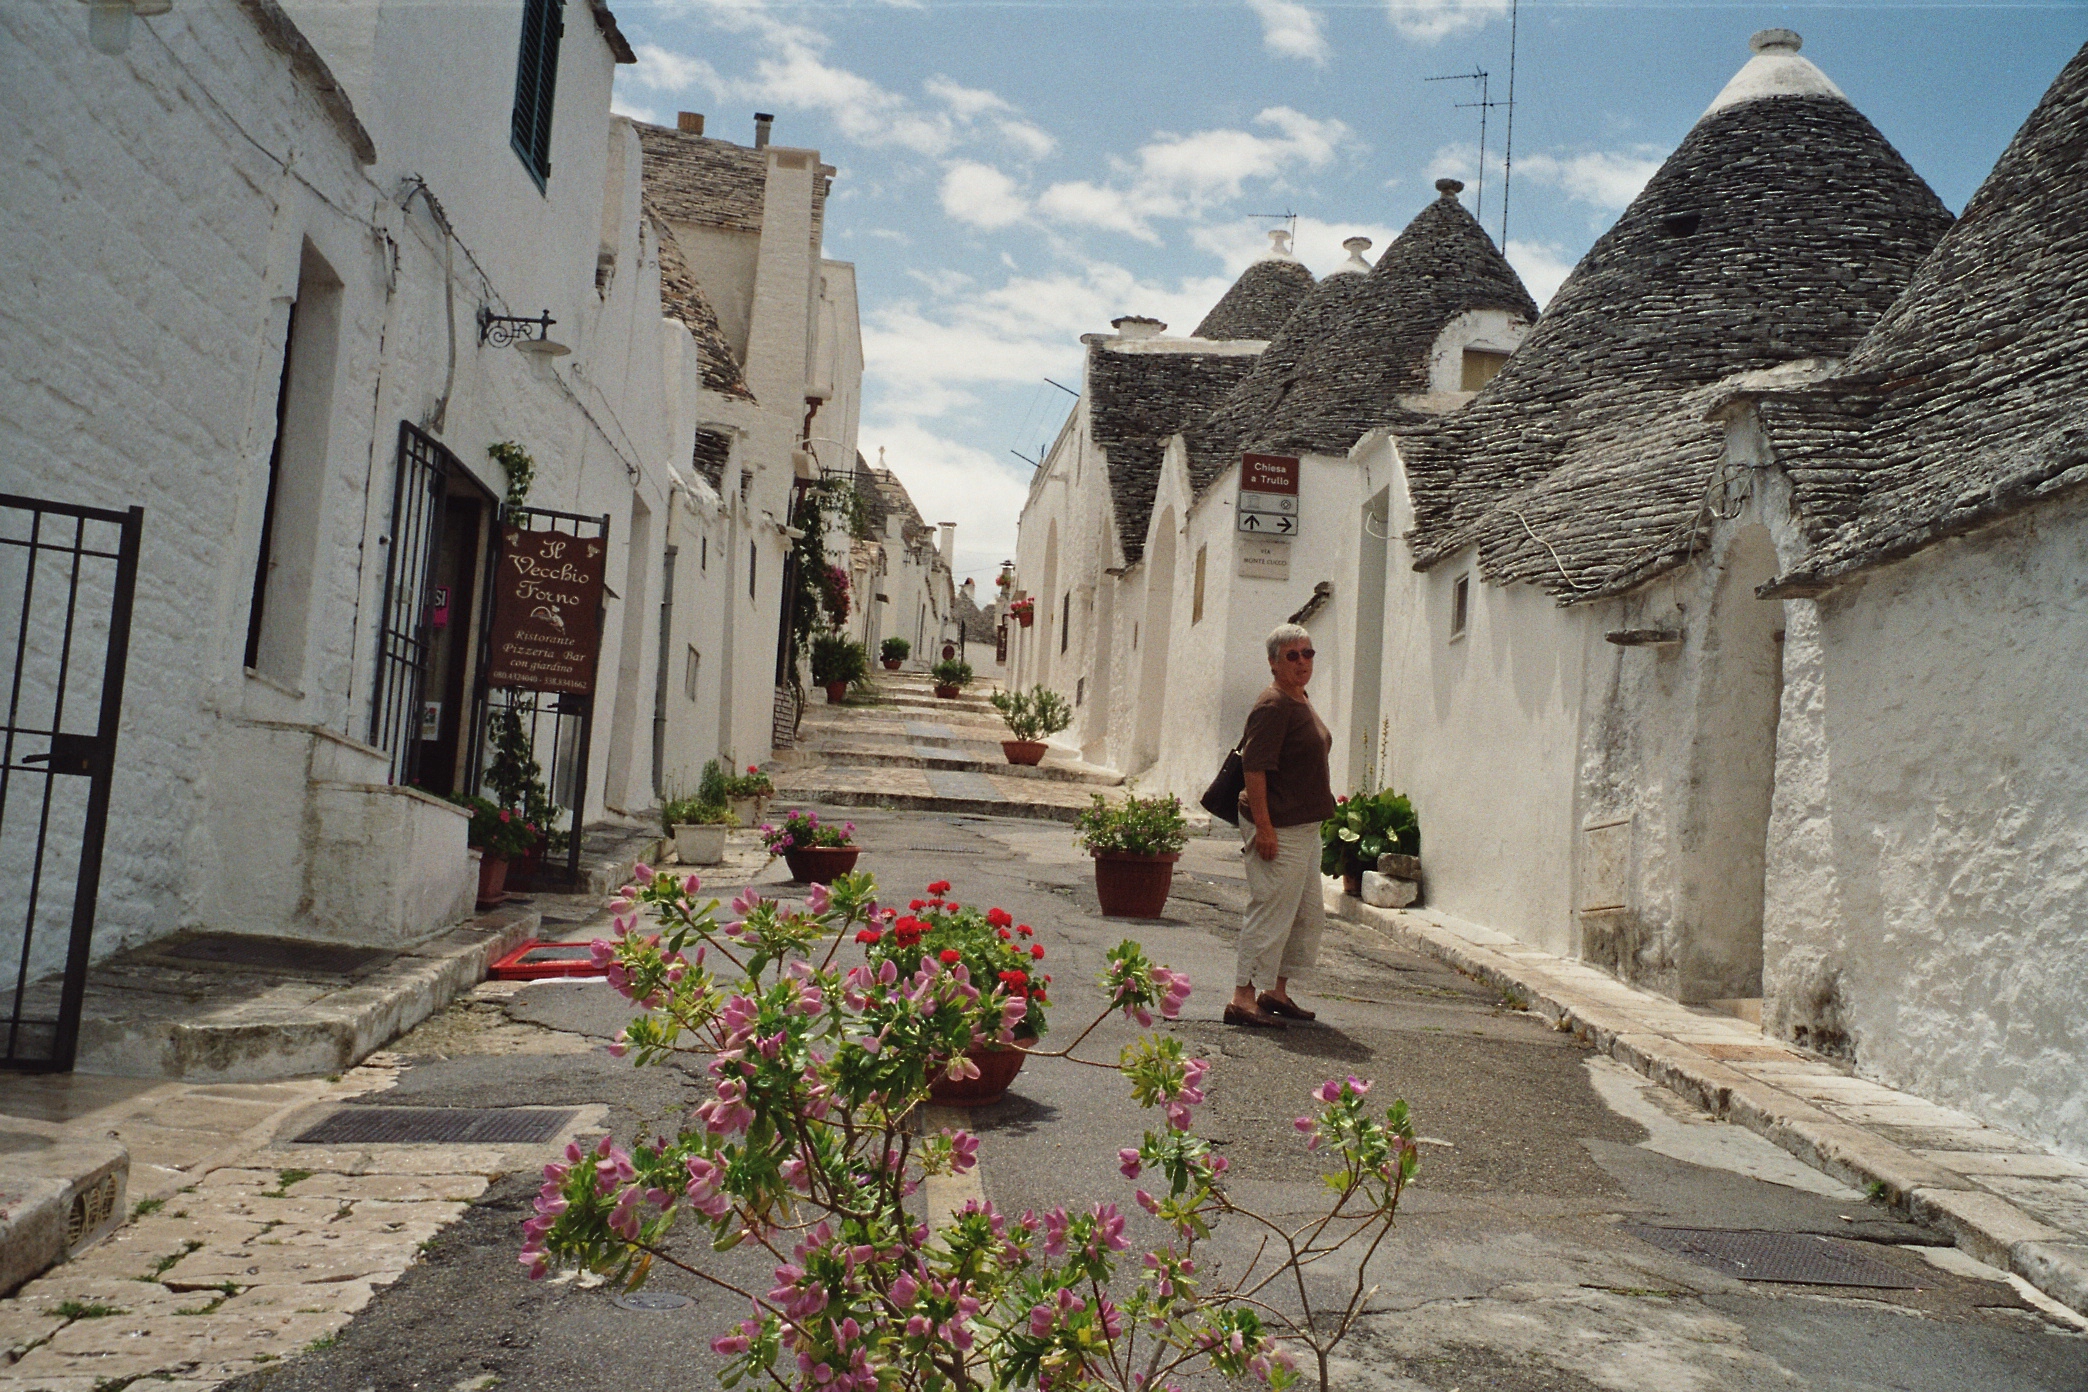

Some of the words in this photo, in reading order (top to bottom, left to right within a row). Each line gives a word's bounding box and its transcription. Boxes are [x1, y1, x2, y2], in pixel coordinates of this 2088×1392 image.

[1254, 462, 1287, 473] Chiesa
[1261, 475, 1289, 486] Trullo
[540, 540, 566, 559] Il
[509, 554, 589, 584] Vecchio
[1243, 557, 1266, 565] MONTE
[516, 580, 580, 605] Forno
[515, 630, 576, 646] Ristorante
[502, 643, 555, 658] Pizzeria
[563, 650, 586, 662] Bar
[510, 660, 528, 668] con
[529, 660, 573, 673] giardino
